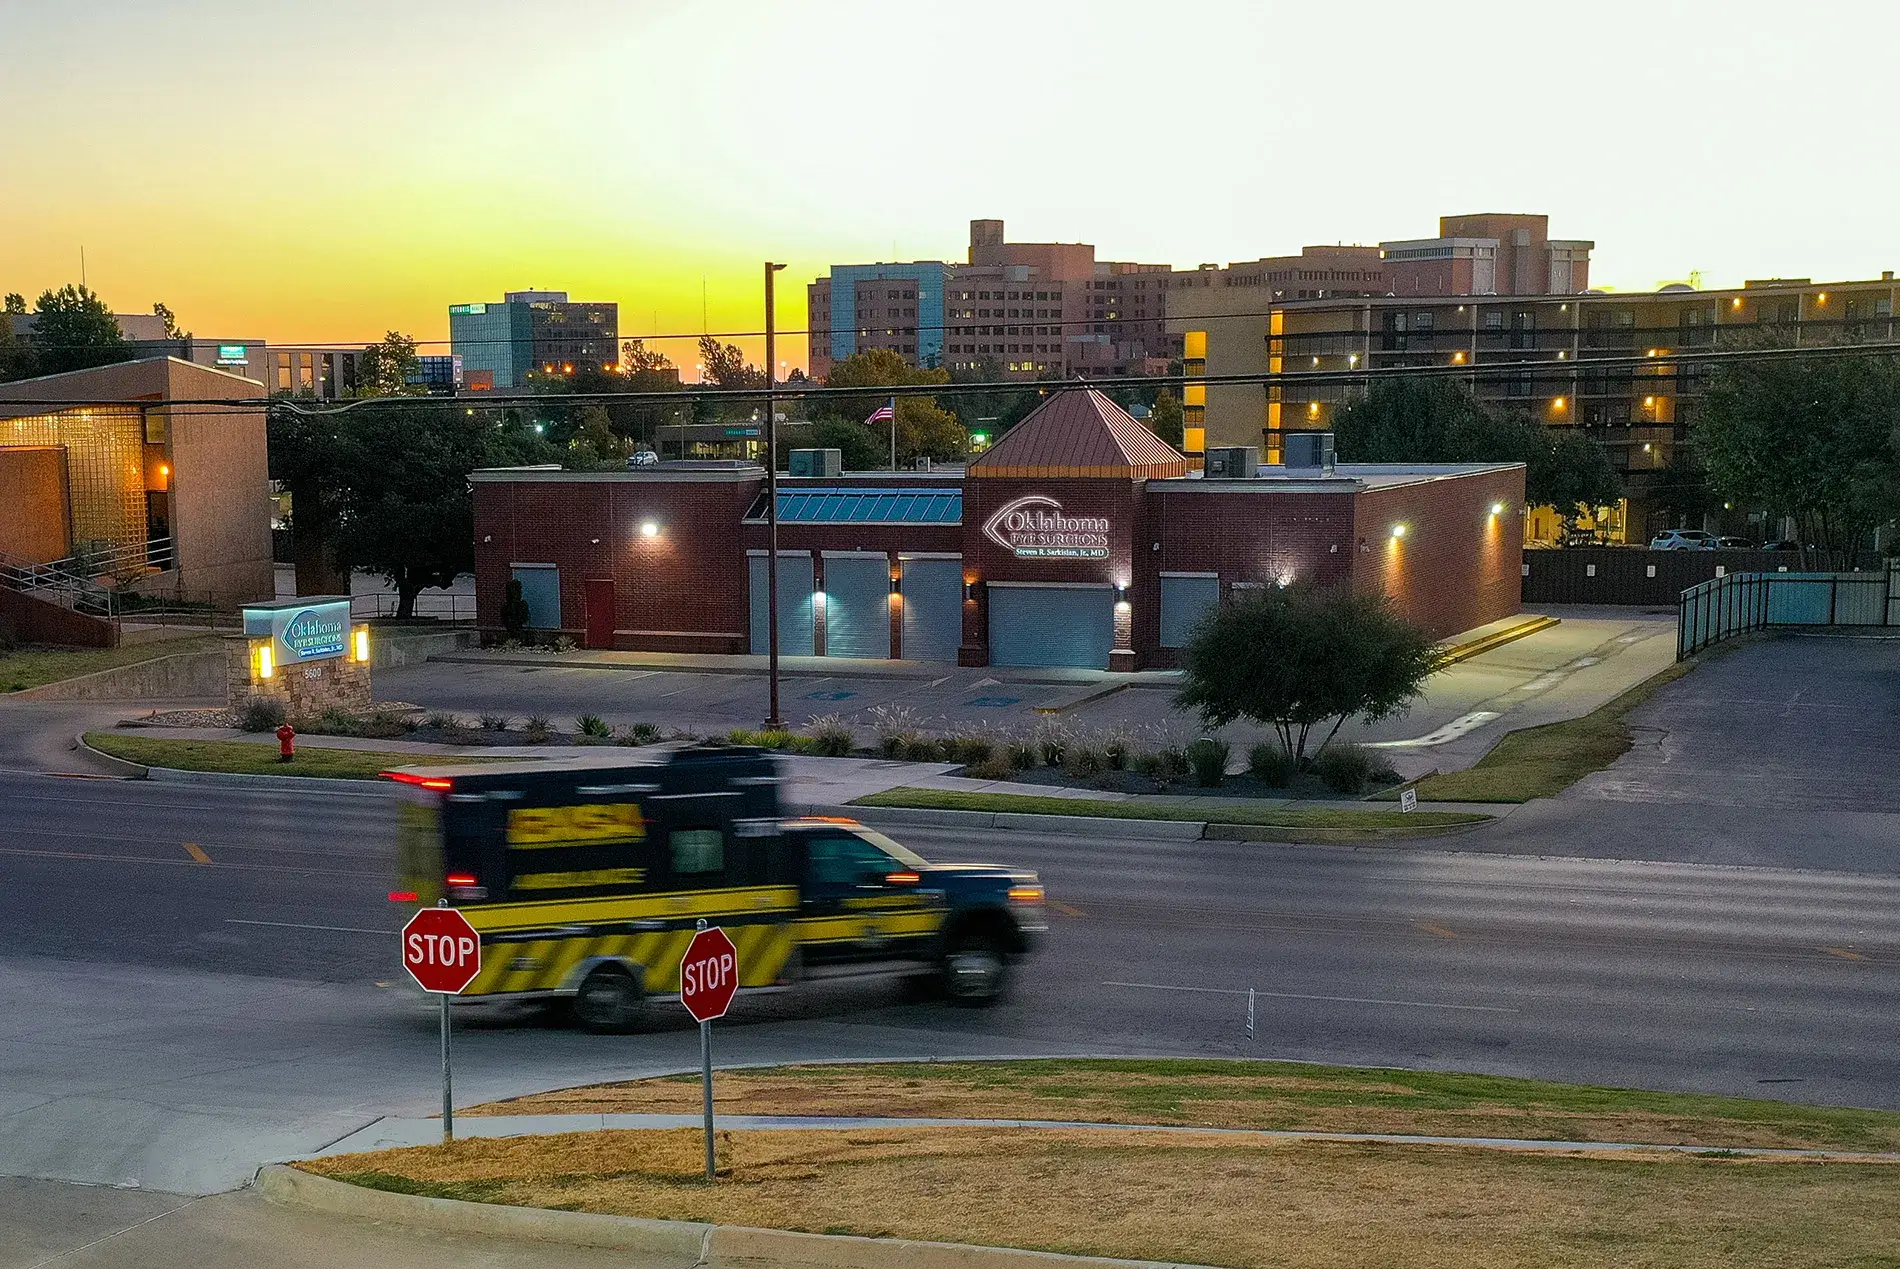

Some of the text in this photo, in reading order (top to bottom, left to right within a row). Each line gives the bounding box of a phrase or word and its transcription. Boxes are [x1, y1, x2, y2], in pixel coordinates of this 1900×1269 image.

[1005, 511, 1109, 532] Oklahoma
[1038, 533, 1108, 546] SURGEONS
[1090, 548, 1104, 556] MD
[291, 620, 342, 638] Oklahoma
[409, 933, 474, 967] STOP
[684, 953, 733, 996] STOP
